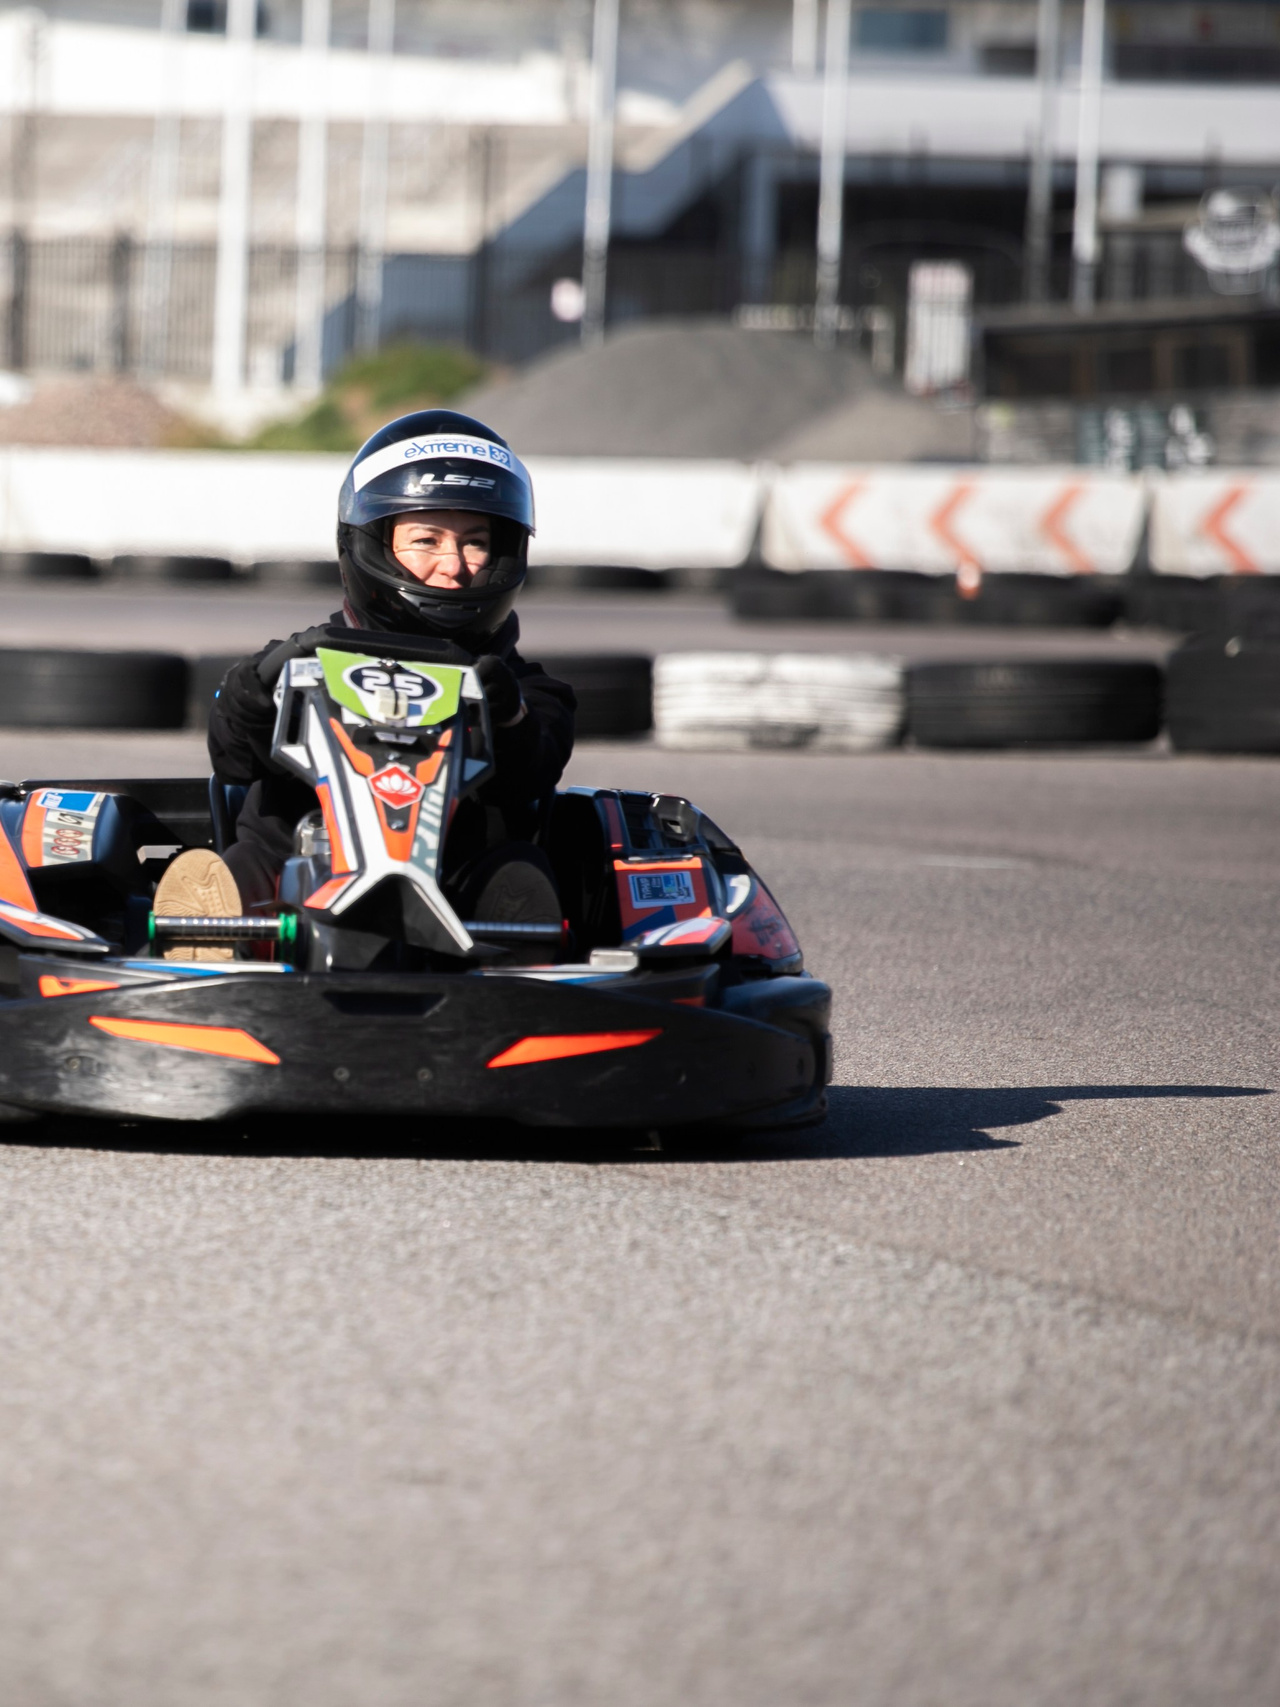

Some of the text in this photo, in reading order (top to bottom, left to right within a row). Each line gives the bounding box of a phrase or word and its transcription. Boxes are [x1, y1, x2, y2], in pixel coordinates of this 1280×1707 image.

[491, 447, 509, 465] 39
[420, 473, 496, 489] LS2
[361, 669, 424, 698] 25
